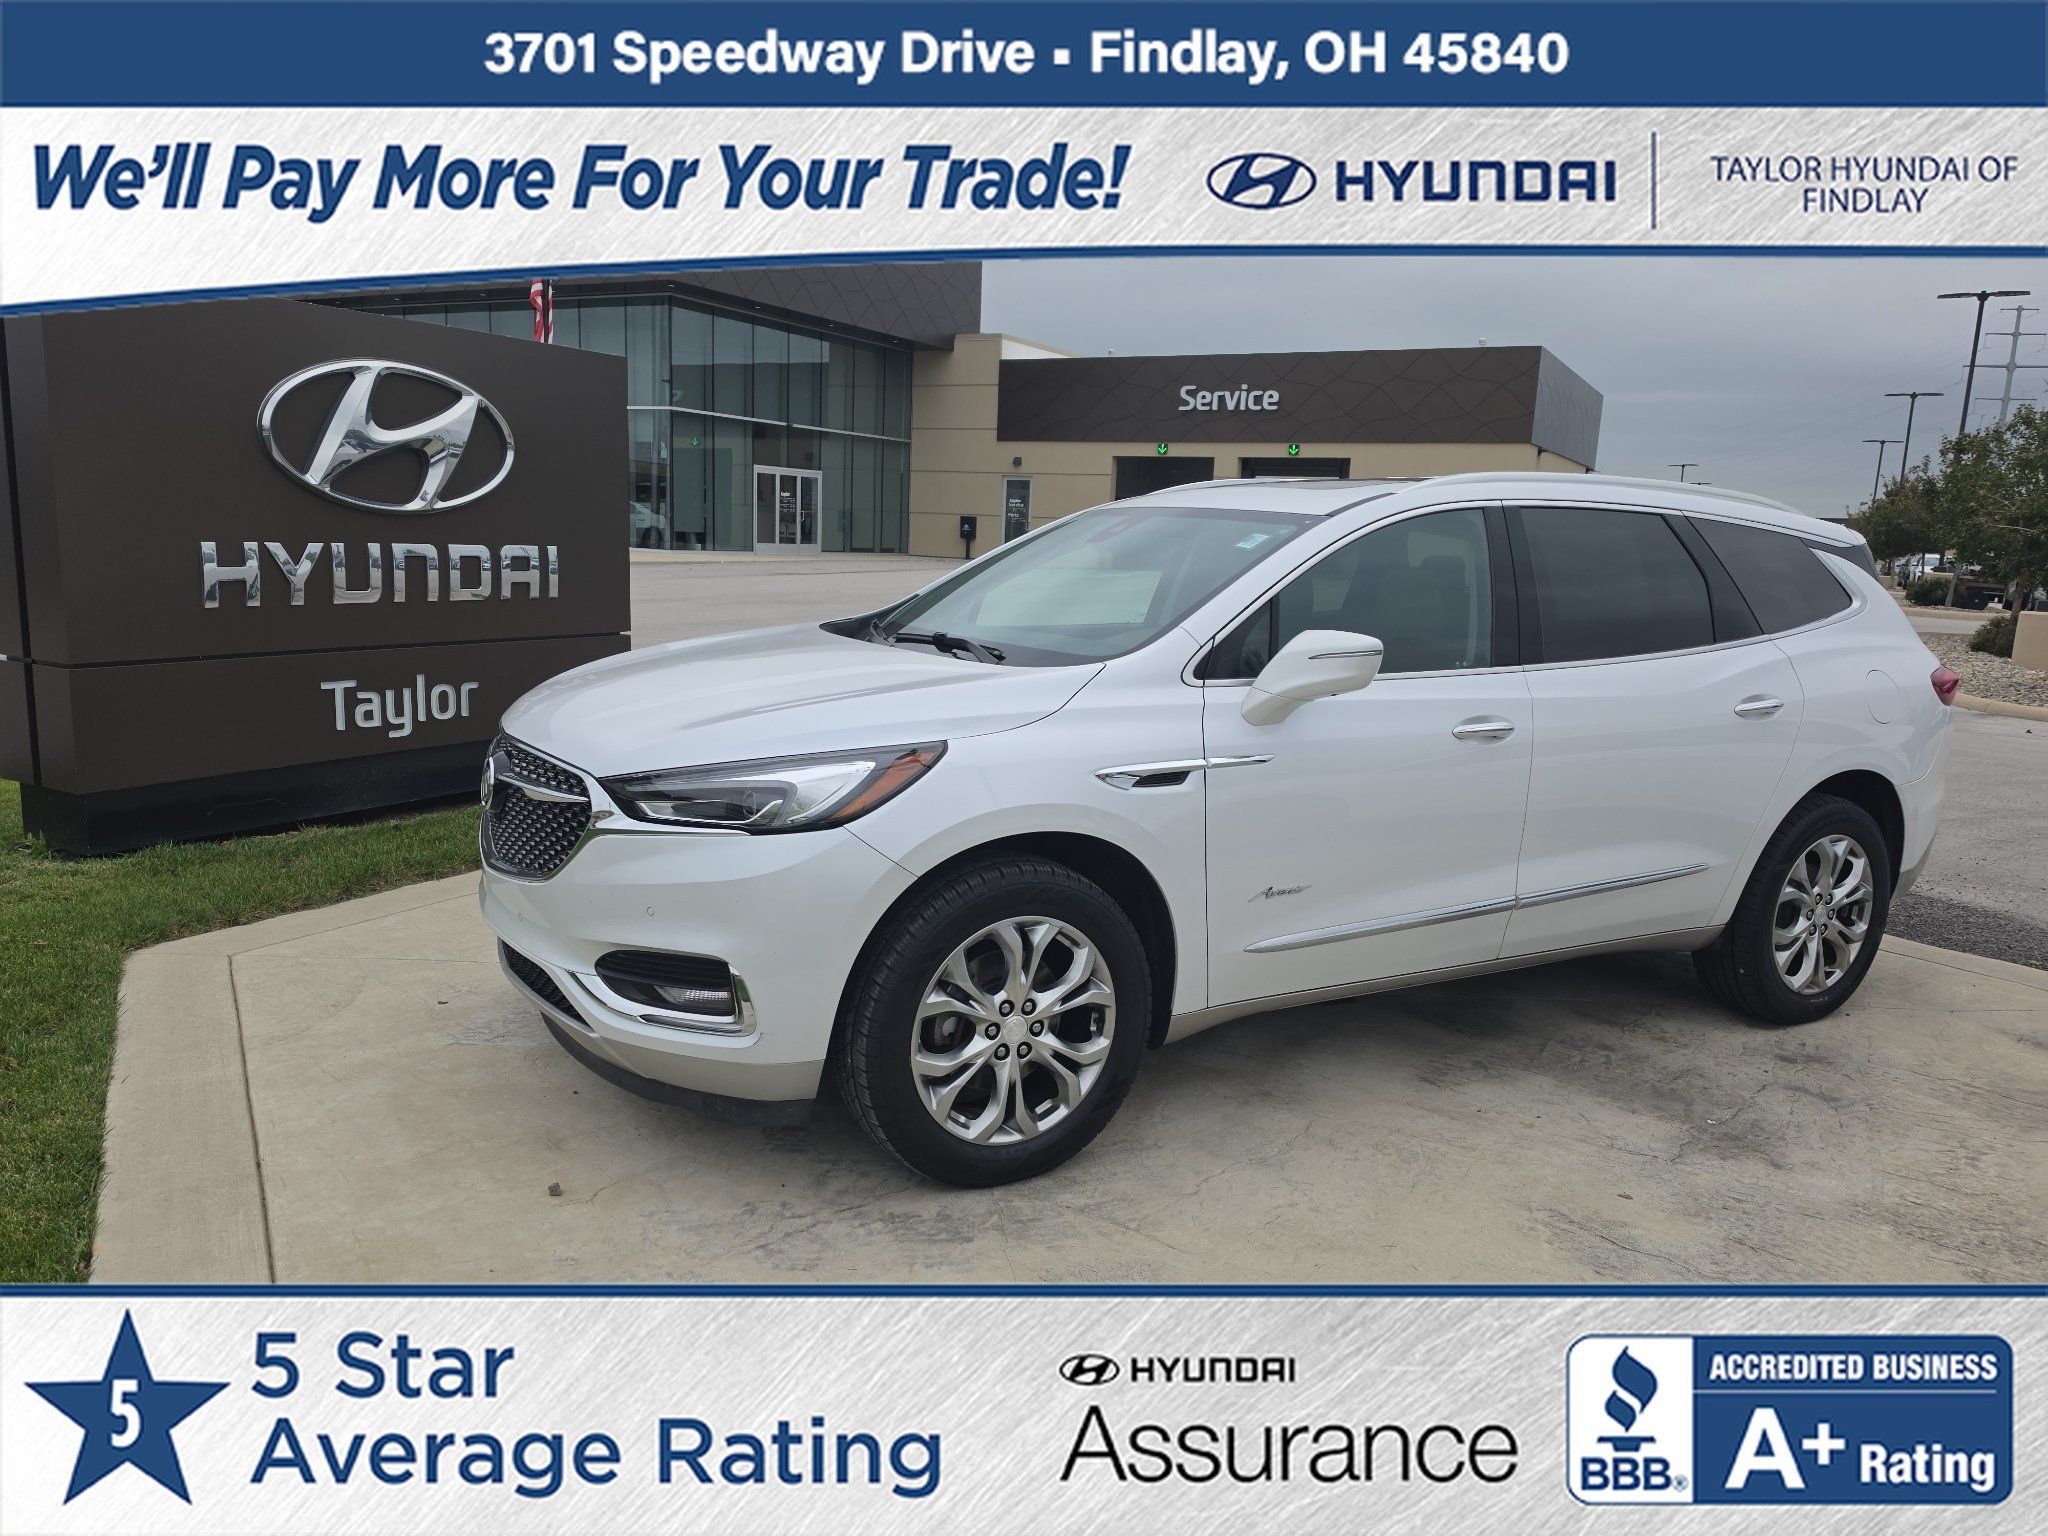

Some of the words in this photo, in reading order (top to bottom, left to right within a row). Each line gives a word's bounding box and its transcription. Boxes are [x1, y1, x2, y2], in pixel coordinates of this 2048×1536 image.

[1178, 383, 1280, 412] Service
[200, 540, 561, 610] HYUNDAI
[320, 673, 480, 740] Taylor
